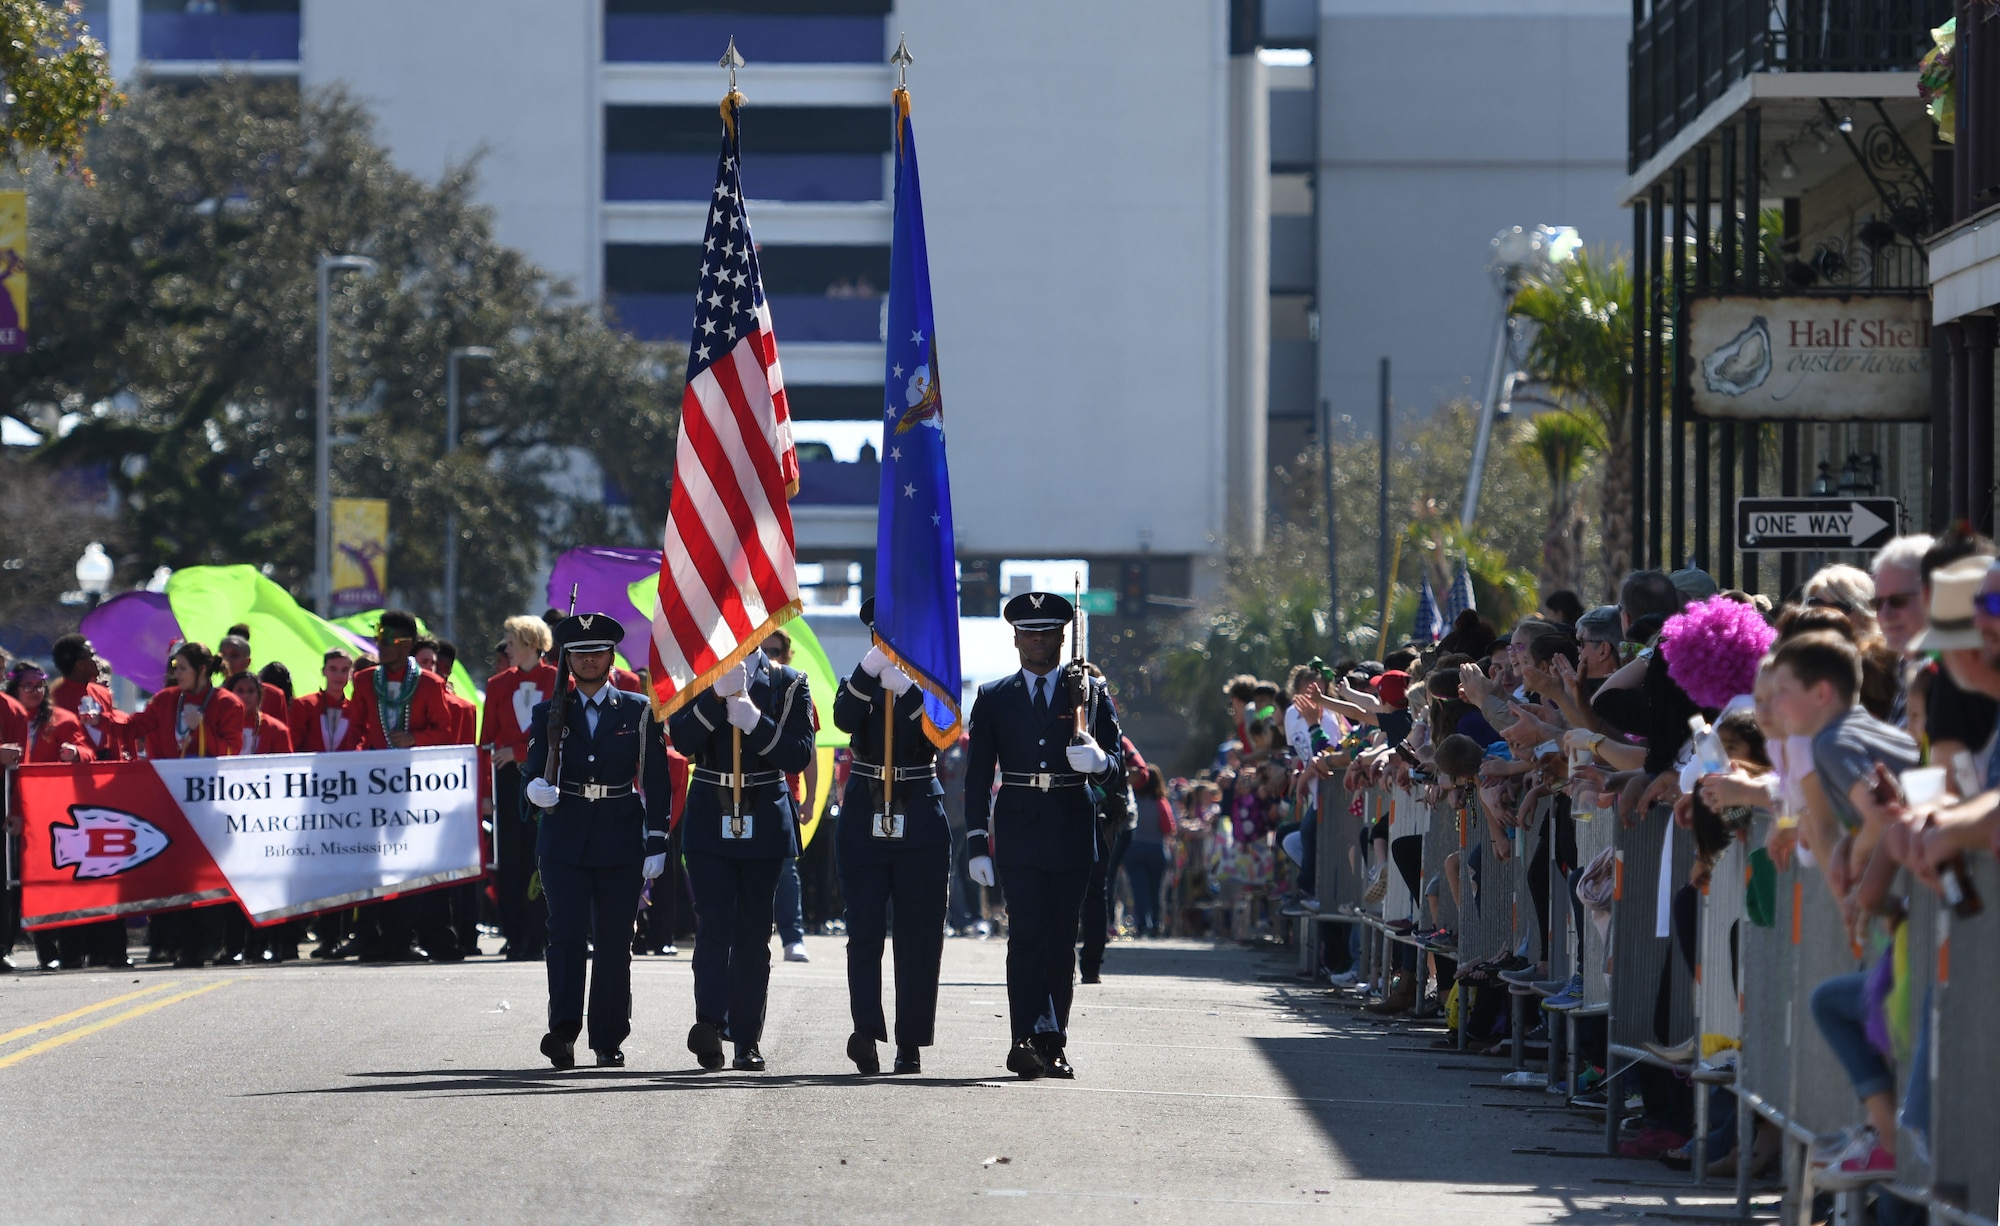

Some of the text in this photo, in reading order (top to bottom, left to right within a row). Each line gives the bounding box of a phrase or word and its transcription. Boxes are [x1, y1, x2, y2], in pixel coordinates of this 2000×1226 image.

[1788, 318, 1930, 348] Half Shell
[1755, 515, 1853, 534] ONE WAY
[184, 765, 469, 804] Biloxi High School
[224, 807, 441, 835] MARCHING BAND
[85, 829, 137, 858] B
[320, 840, 408, 858] Mississippi
